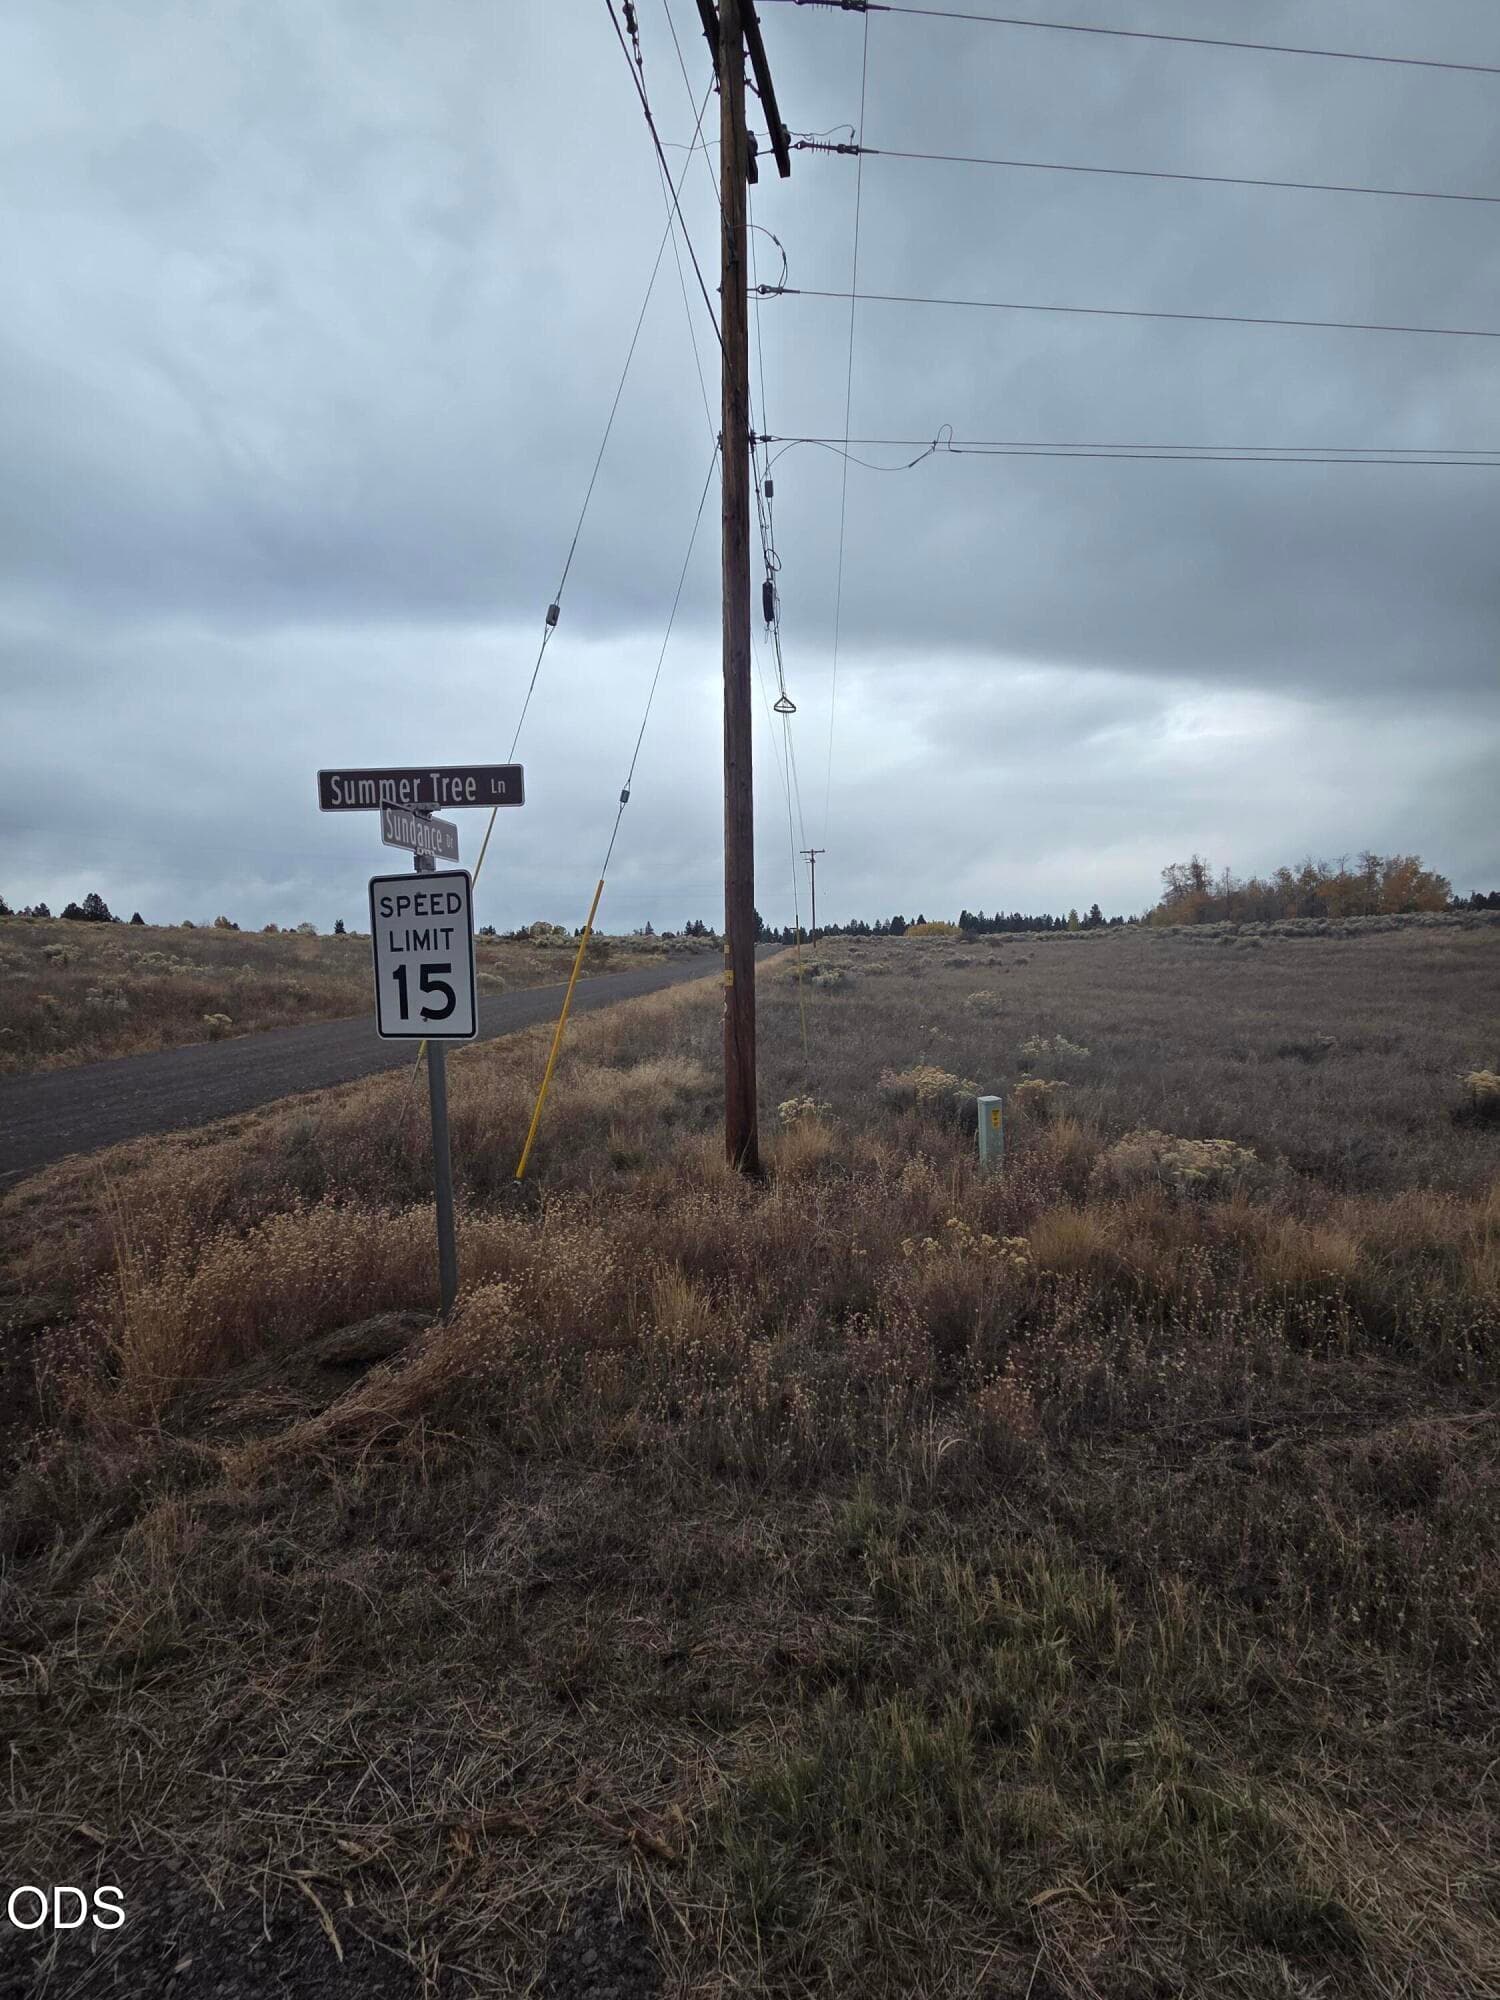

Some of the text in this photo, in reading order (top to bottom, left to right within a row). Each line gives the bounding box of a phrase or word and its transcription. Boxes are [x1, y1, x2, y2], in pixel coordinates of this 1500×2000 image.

[331, 773, 506, 805] Summer Tree Ln
[386, 808, 442, 852] Sundance
[380, 892, 462, 918] SPEED
[390, 928, 454, 952] LIMIT
[392, 963, 456, 1020] 15
